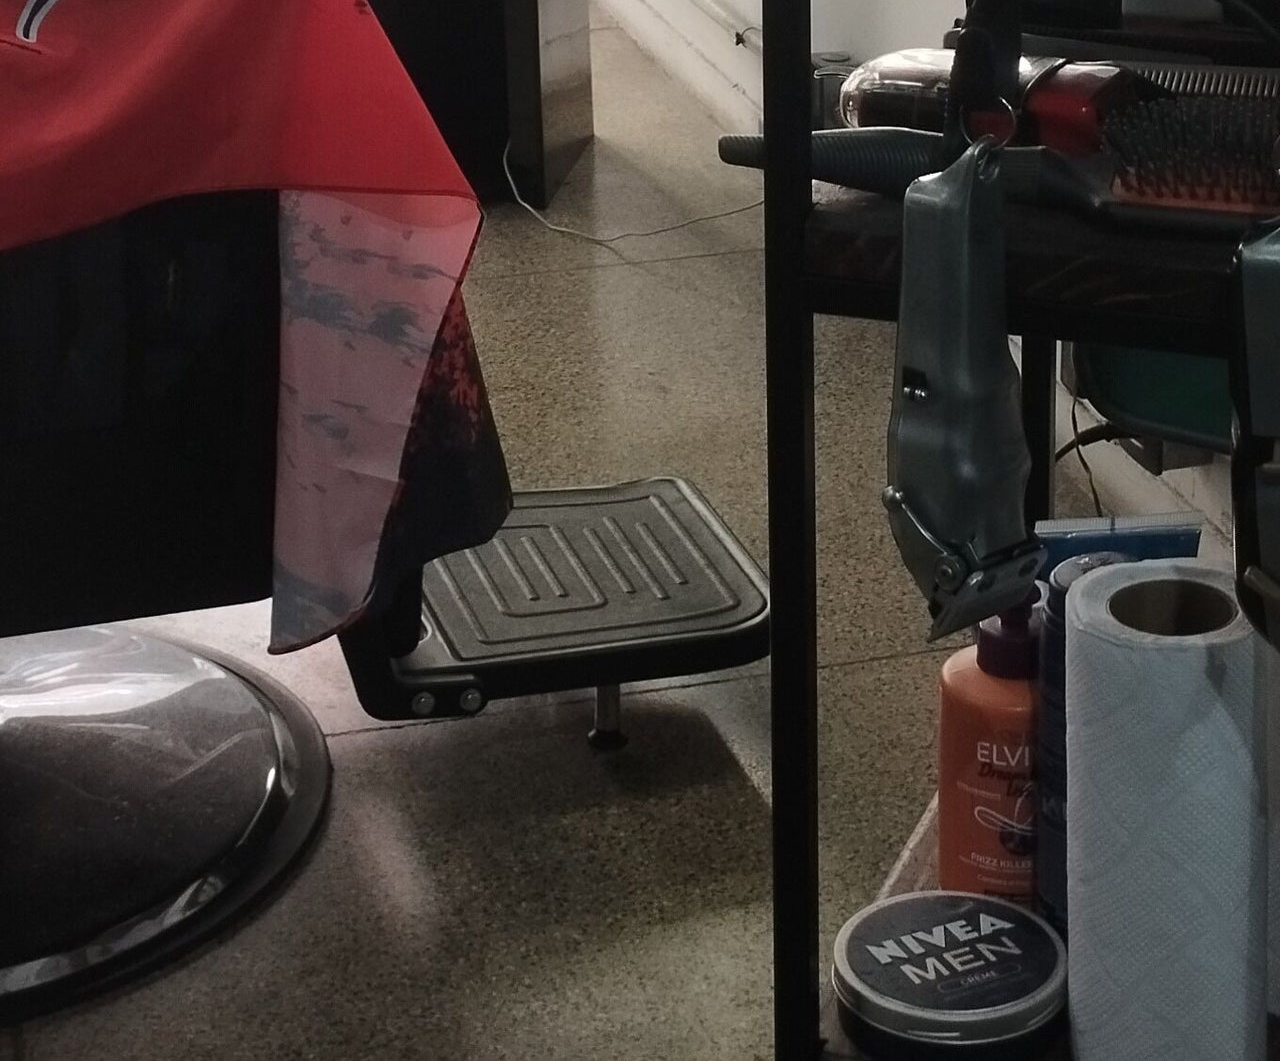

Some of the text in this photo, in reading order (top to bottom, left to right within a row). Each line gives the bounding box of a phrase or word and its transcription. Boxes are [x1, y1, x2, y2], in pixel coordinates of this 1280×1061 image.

[976, 741, 1030, 767] ELVI
[864, 912, 1016, 965] NIVEA
[899, 936, 1023, 986] MEN
